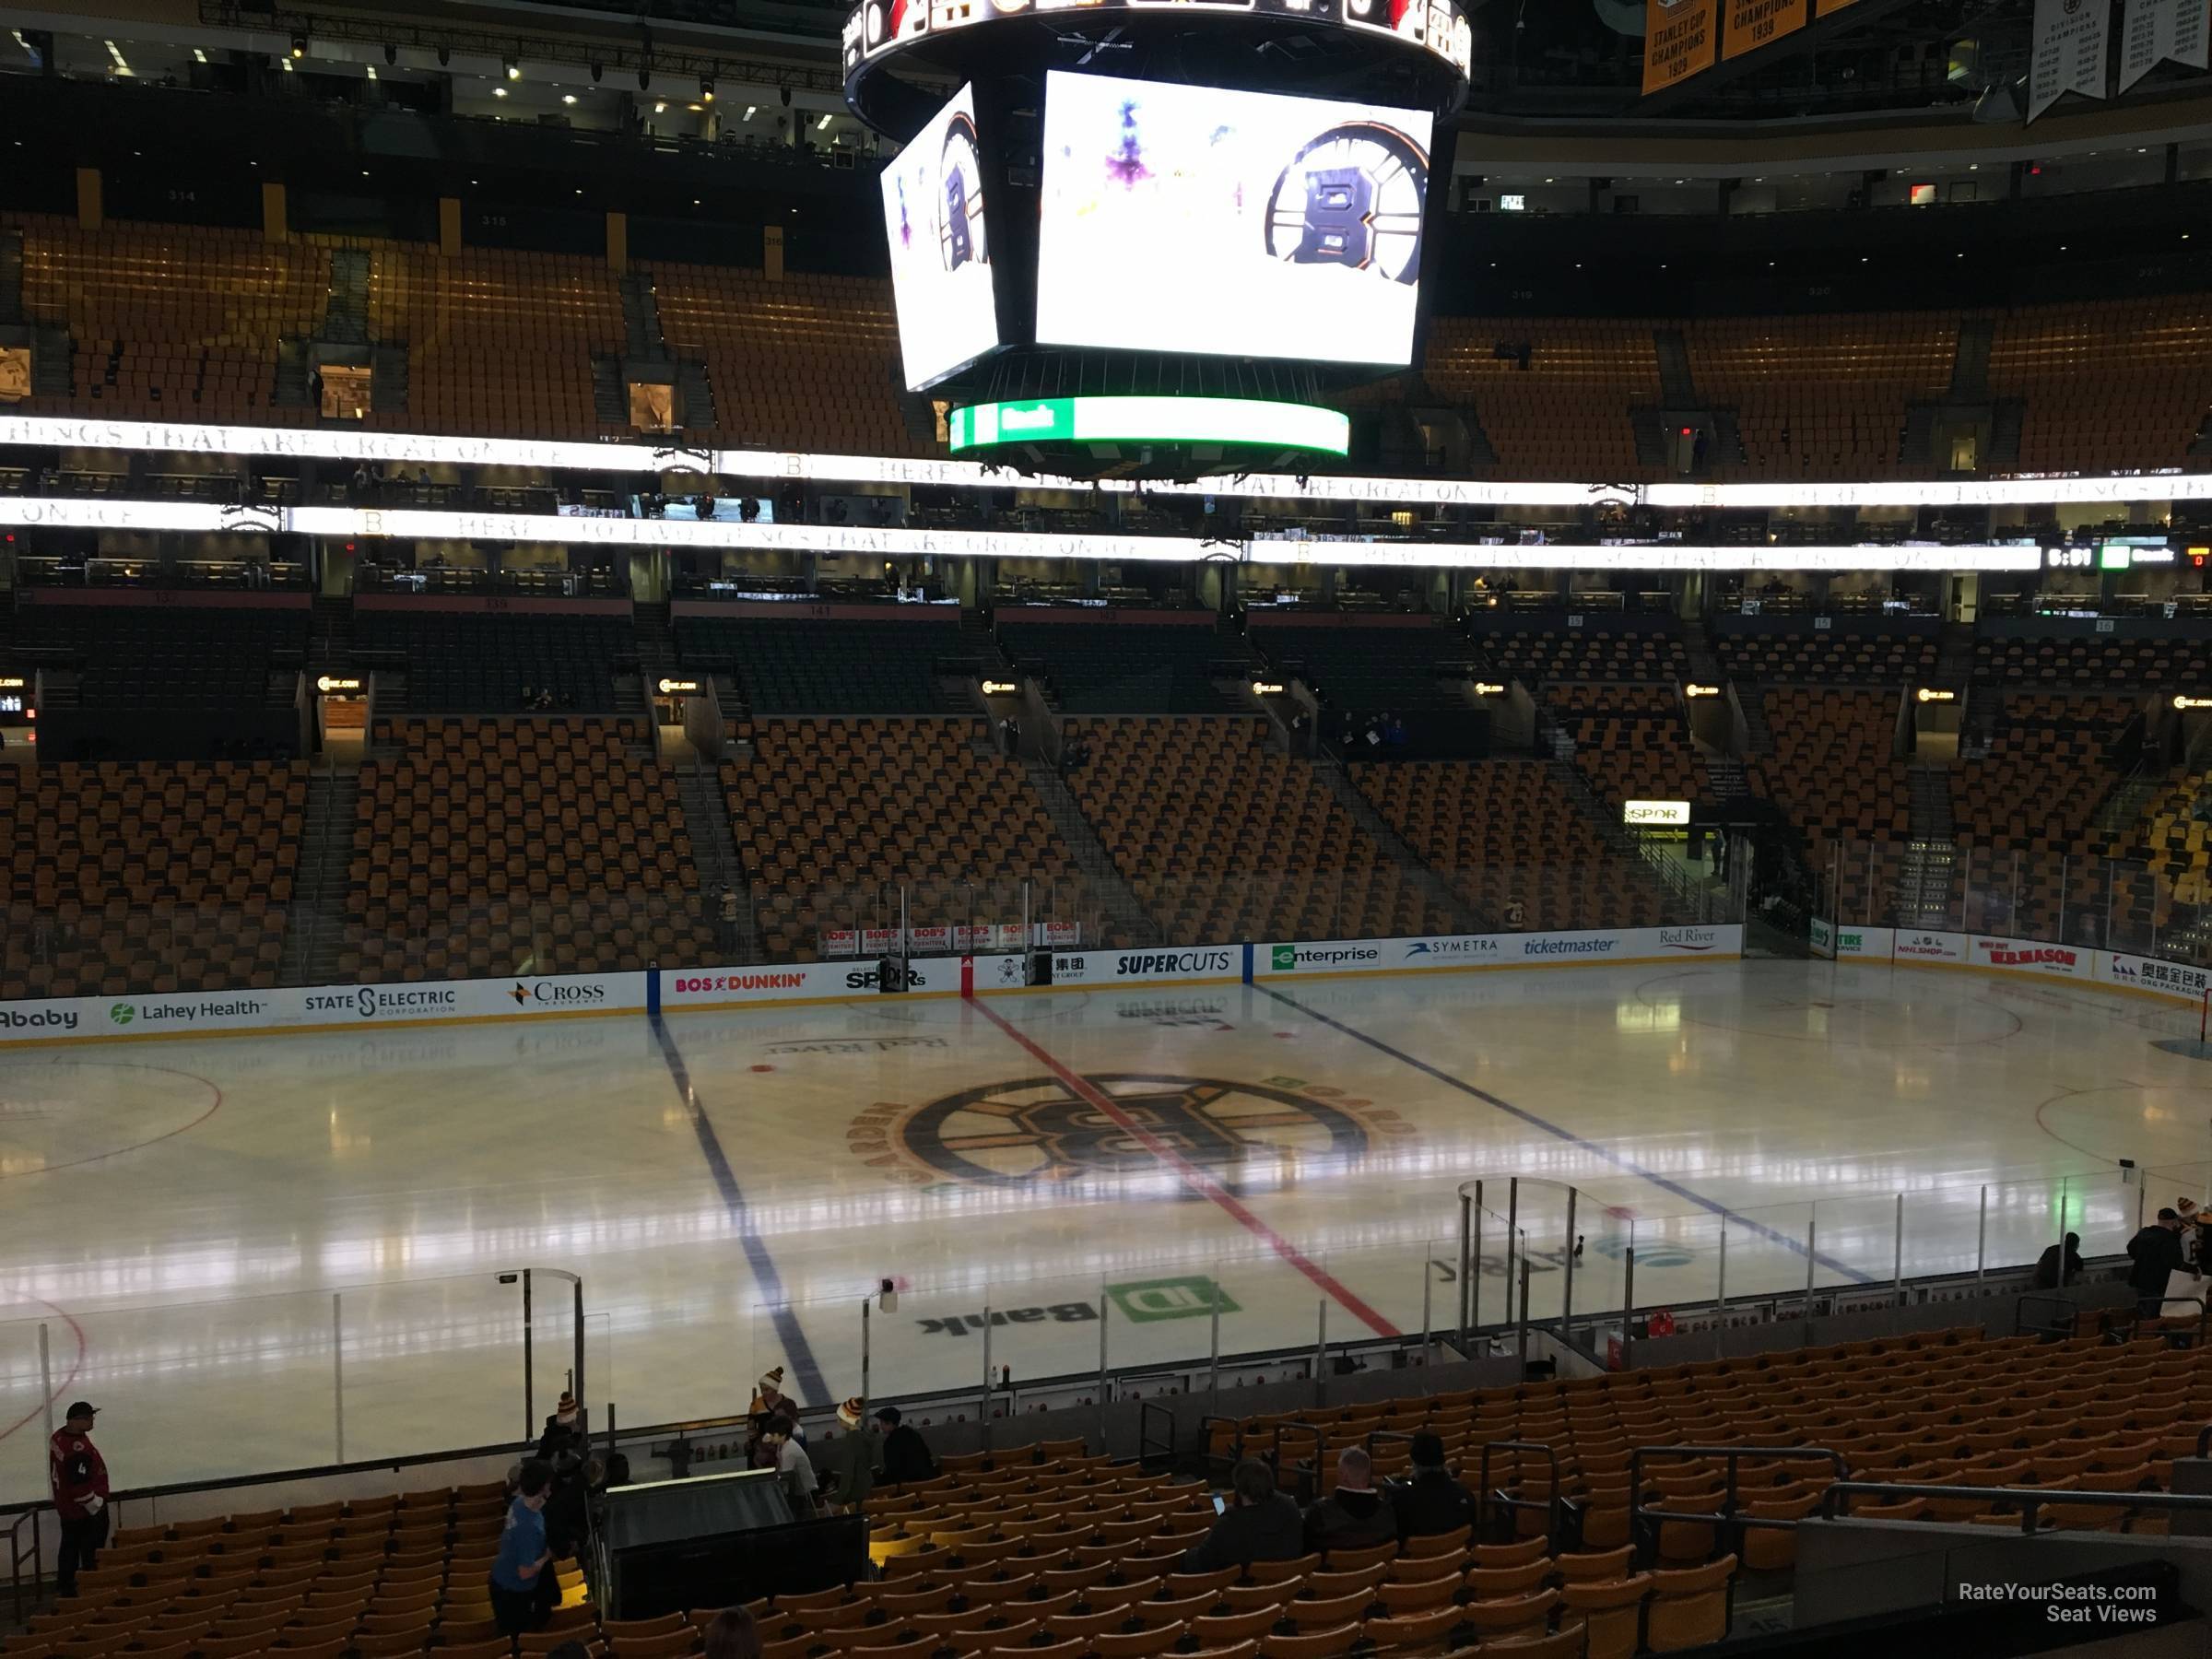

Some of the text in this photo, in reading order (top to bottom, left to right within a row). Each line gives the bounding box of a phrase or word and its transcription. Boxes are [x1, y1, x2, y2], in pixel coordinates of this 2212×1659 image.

[1735, 0, 1794, 29] CHAMPIONS
[2051, 12, 2091, 31] DIVISION
[1653, 9, 1705, 47] STANLEY CUP
[1752, 18, 1774, 42] 1939
[2044, 20, 2097, 45] CHAMPIONS
[1652, 29, 1705, 66] CHAMPIONS
[1669, 57, 1688, 79] 1929
[913, 927, 946, 937] BOB'S
[1659, 929, 1716, 943] Red River
[1274, 947, 1379, 965] enterprise
[1432, 940, 1499, 953] SYMETRA
[1524, 938, 1615, 955] ticketmaster
[1116, 952, 1230, 975] SUPERCUTS
[676, 972, 806, 993] BOS DUNKIN'
[2139, 977, 2159, 987] ORG
[143, 1000, 259, 1020] Lahey Health
[305, 996, 354, 1010] STATE
[379, 991, 456, 1006] ELECTRIC
[379, 1006, 456, 1016] CORPORATION
[915, 1301, 1099, 1337] Bank
[77, 1463, 87, 1475] 4
